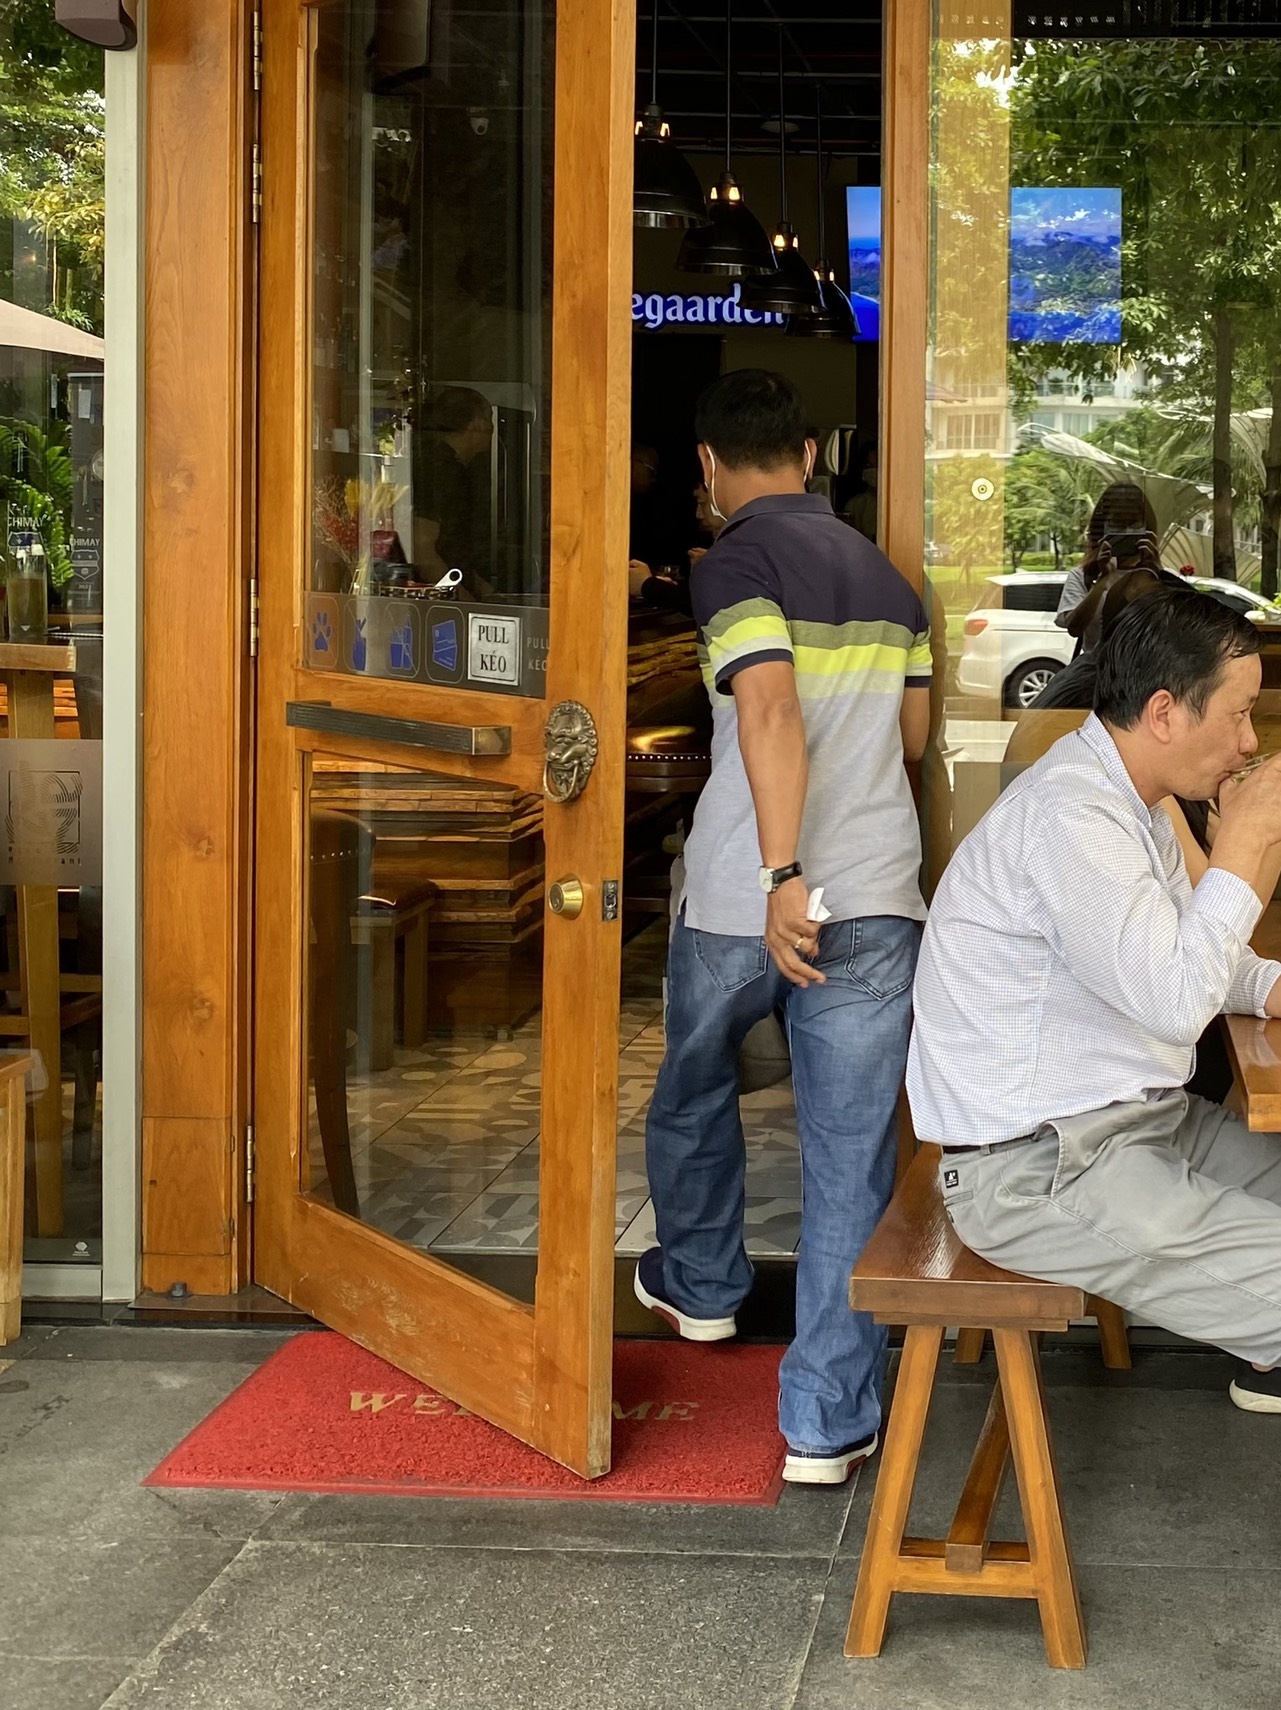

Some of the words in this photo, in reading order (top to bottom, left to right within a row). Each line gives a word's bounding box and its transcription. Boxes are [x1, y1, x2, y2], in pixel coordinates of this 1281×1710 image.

[478, 625, 509, 644] PULL
[526, 637, 551, 650] PULL
[480, 650, 507, 673] KÉO
